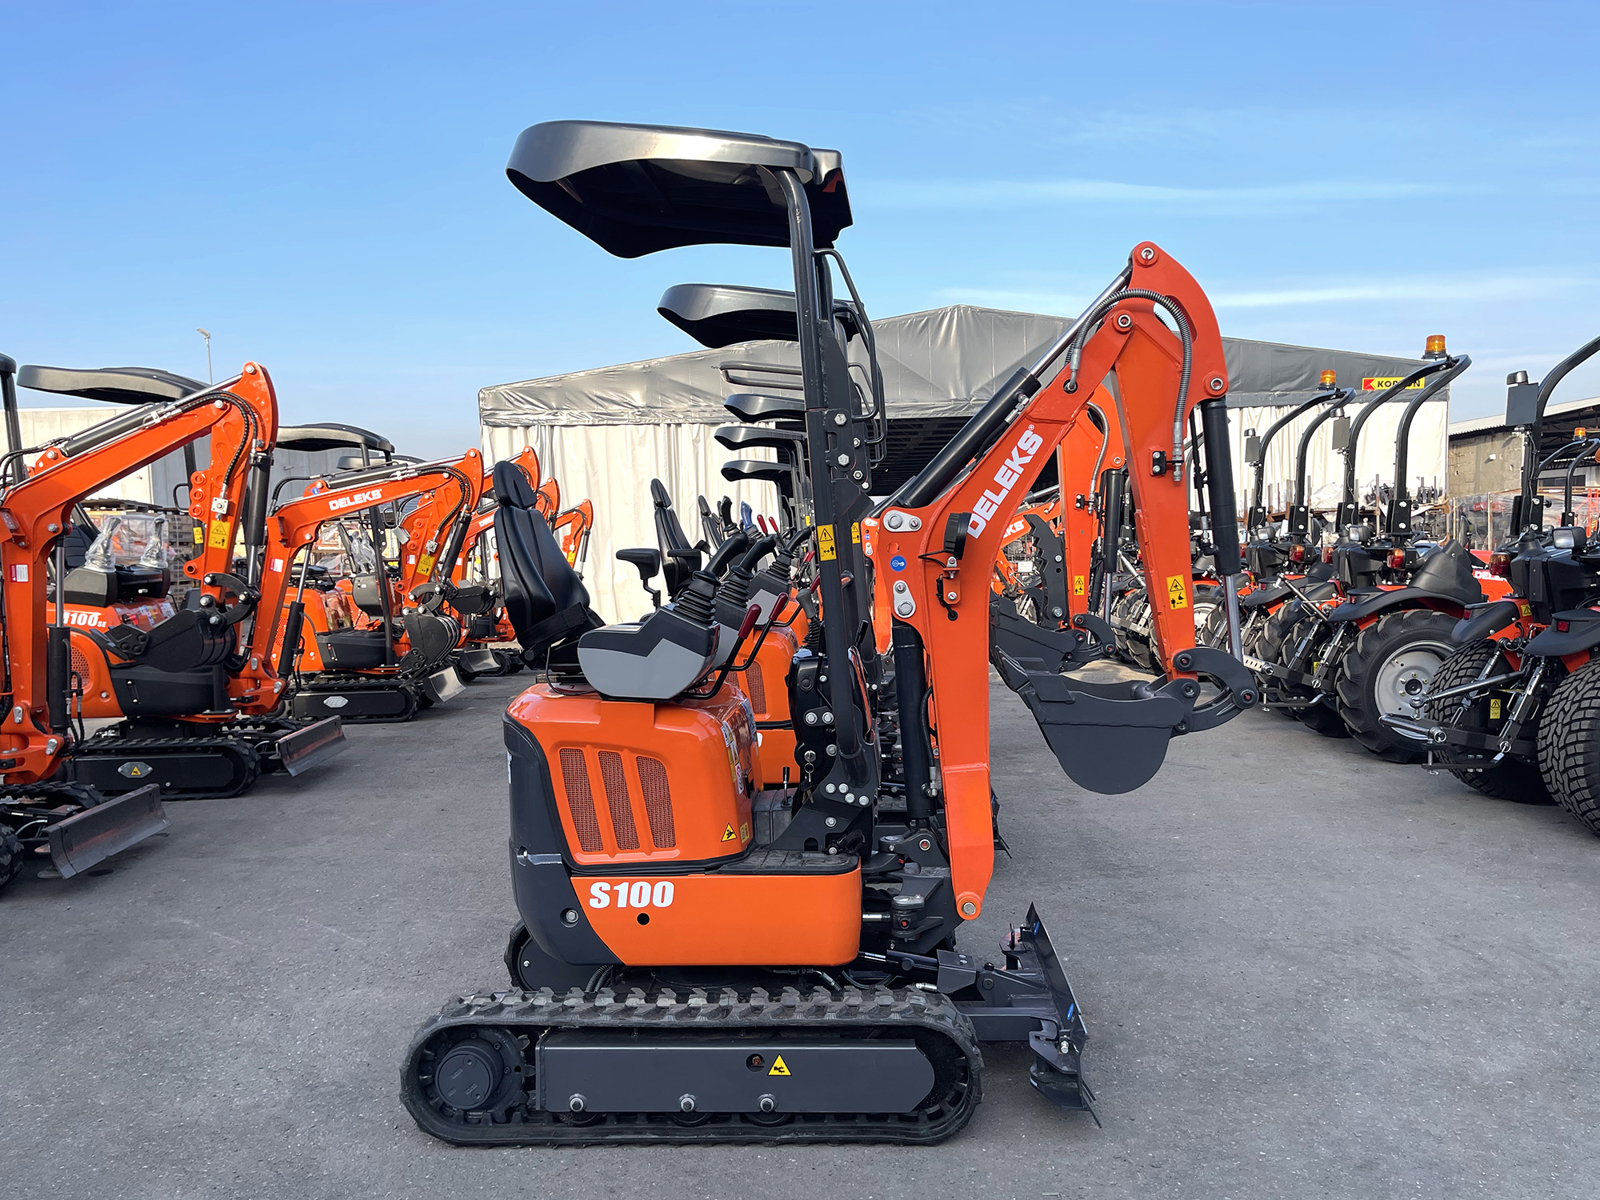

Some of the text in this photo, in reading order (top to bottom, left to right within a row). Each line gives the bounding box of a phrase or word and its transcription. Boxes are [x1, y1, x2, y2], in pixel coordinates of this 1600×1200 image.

[967, 429, 1044, 539] DELEKS
[328, 489, 382, 511] DELEKS
[588, 881, 675, 909] S100
